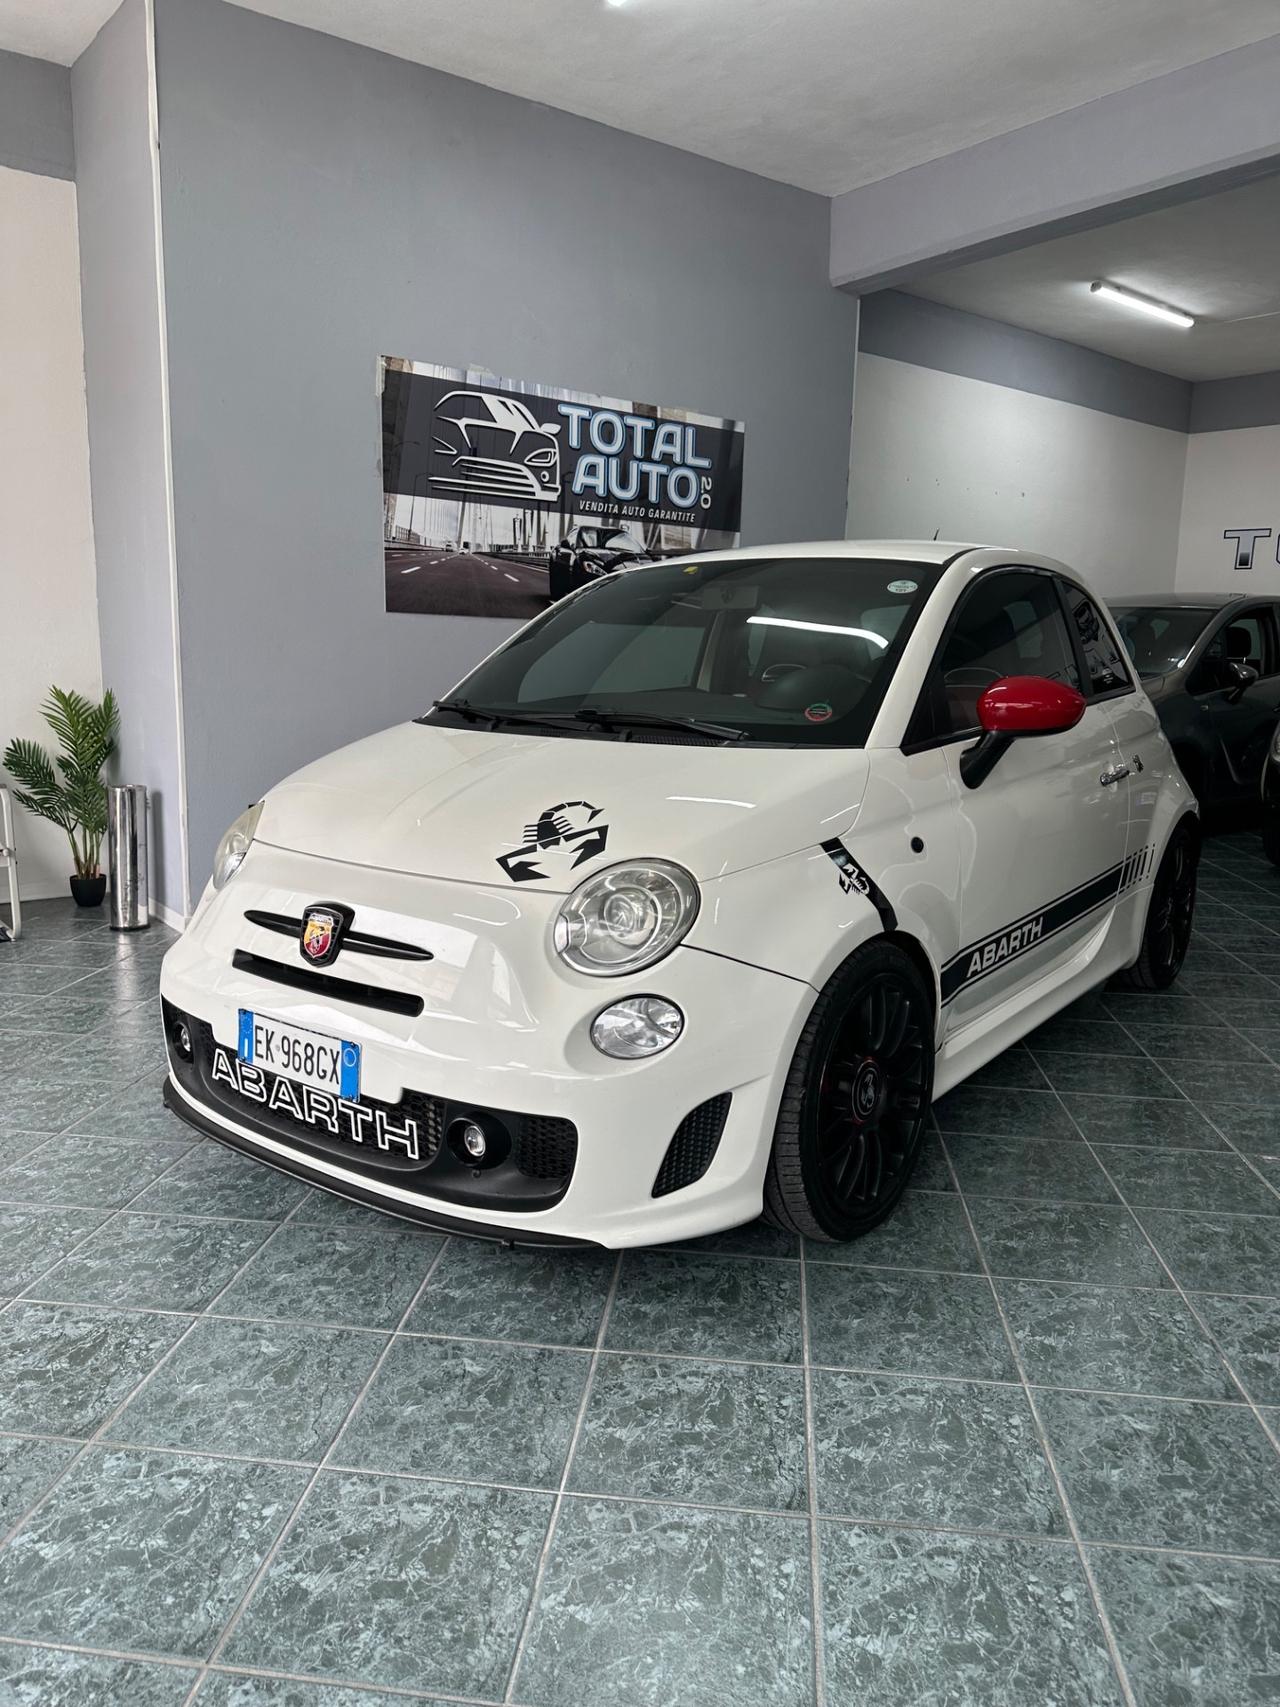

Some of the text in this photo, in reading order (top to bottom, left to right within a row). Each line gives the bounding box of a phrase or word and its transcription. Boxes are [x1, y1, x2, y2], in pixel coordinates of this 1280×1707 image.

[558, 404, 712, 468] TOTAL
[571, 454, 699, 509] AUTO
[701, 477, 712, 509] 2.0
[580, 501, 695, 523] VENDITA AUTO GARANTITE
[1223, 527, 1280, 571] T
[966, 916, 1044, 978] ABARTH
[254, 1025, 341, 1086] EK 968GX
[211, 1047, 420, 1161] ABARTH
